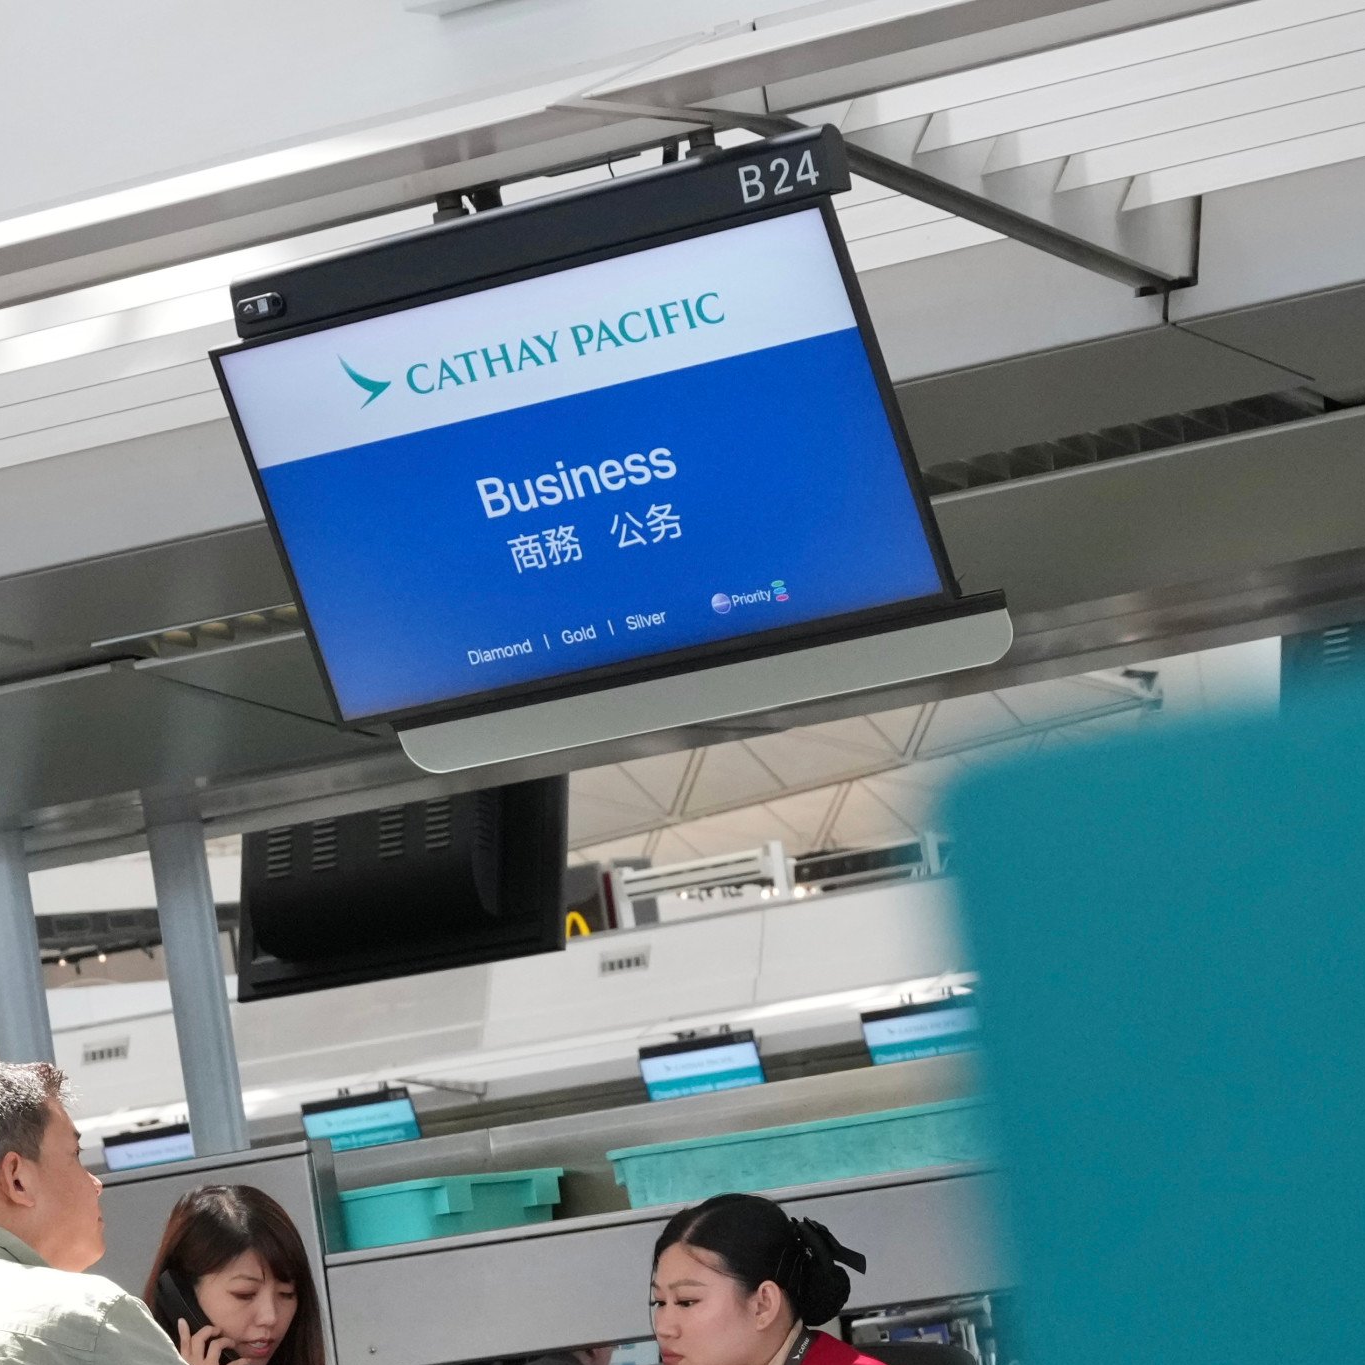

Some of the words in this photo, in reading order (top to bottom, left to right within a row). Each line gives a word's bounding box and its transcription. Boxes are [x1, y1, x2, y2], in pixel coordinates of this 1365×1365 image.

[738, 150, 820, 203] B24
[406, 330, 559, 396] CATHAY
[571, 292, 725, 356] PACIFIC
[476, 447, 677, 518] Business
[507, 525, 584, 574] 商務
[609, 502, 683, 550] 公务
[731, 589, 771, 606] Priority
[467, 638, 532, 666] Diamond
[561, 623, 597, 645] Gold
[625, 609, 666, 632] Silver
